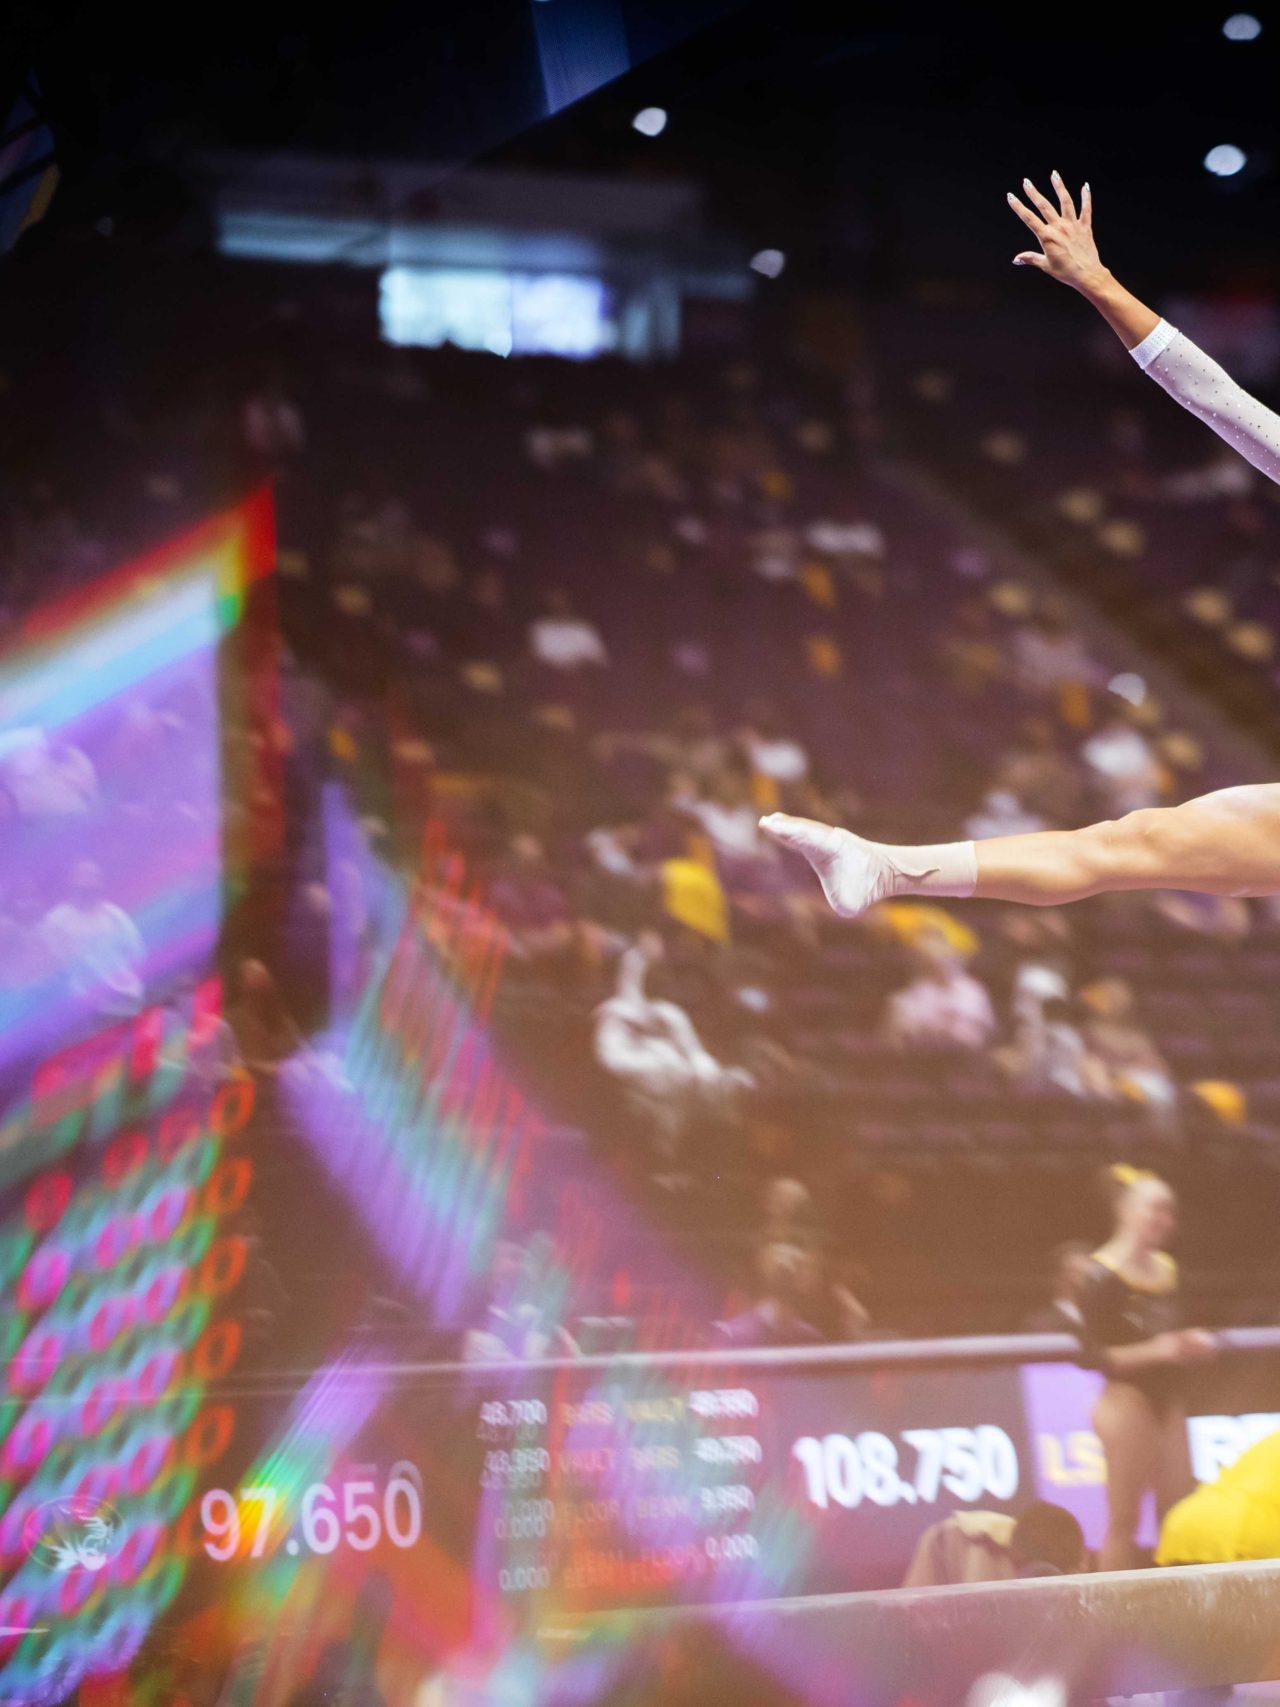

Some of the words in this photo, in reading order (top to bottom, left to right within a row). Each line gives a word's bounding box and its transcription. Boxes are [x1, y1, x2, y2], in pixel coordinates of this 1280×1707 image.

[792, 1424, 1019, 1509] 108.750
[1036, 1431, 1108, 1487] LS
[199, 1477, 422, 1562] 97.650
